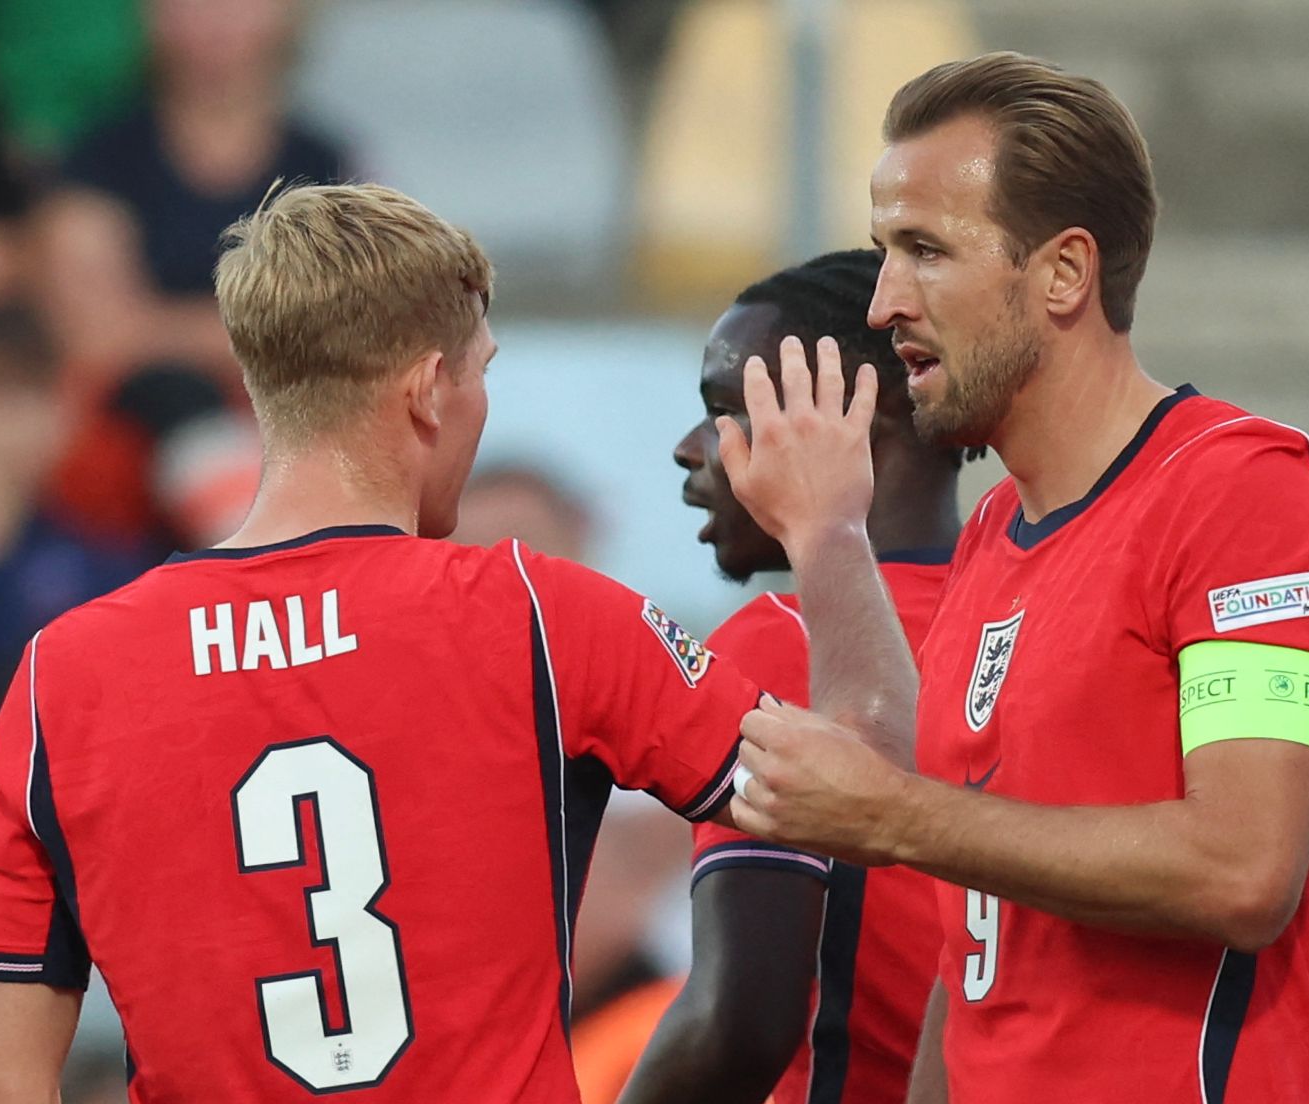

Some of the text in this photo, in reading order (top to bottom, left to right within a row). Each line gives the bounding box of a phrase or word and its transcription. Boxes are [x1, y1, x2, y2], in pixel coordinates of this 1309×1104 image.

[189, 588, 358, 676] HALL
[1212, 588, 1241, 601] UEFA
[230, 735, 415, 1095] 3
[963, 886, 999, 1003] 9
